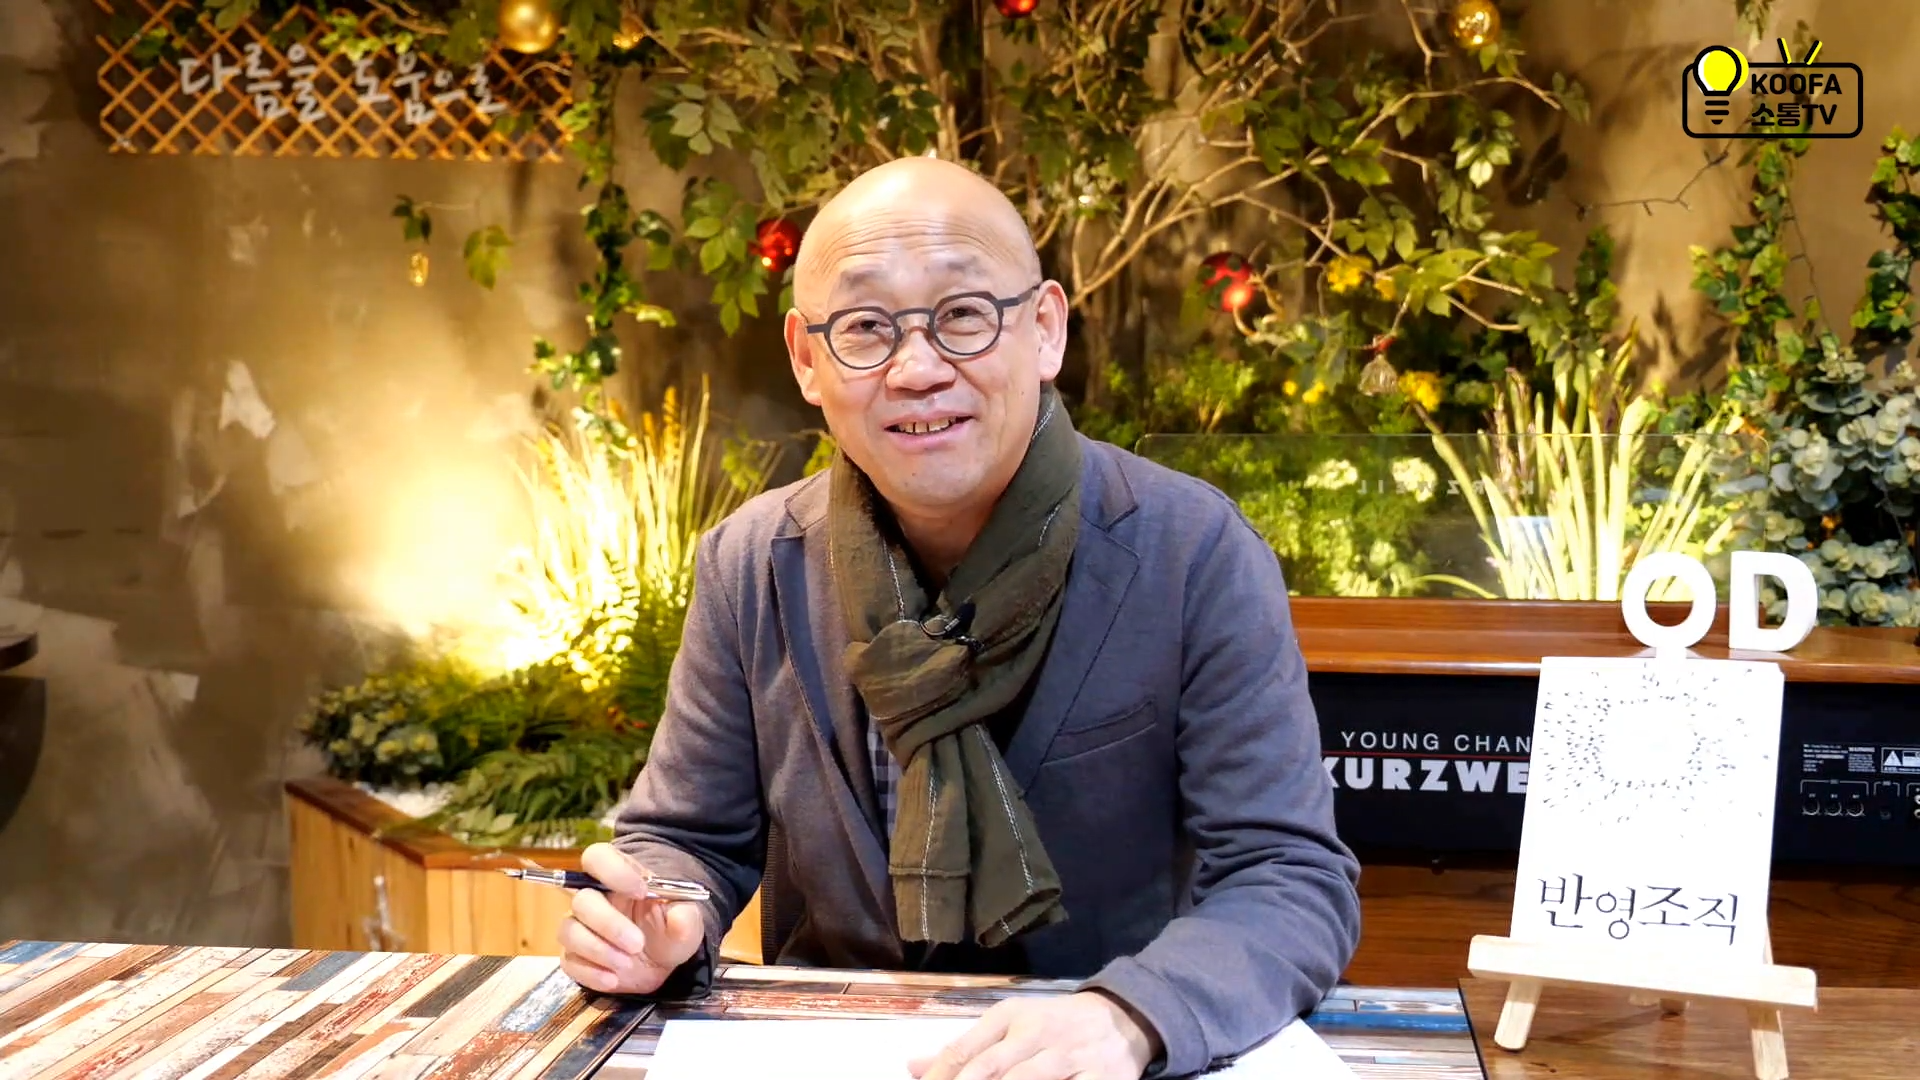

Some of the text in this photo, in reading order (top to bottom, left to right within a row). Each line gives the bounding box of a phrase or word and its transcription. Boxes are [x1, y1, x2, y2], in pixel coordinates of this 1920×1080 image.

[179, 42, 508, 125] 다름을 도움으로
[1621, 551, 1818, 652] OD
[1341, 731, 1530, 752] YOUNG CHAN
[1538, 874, 1738, 946] 반영조직
